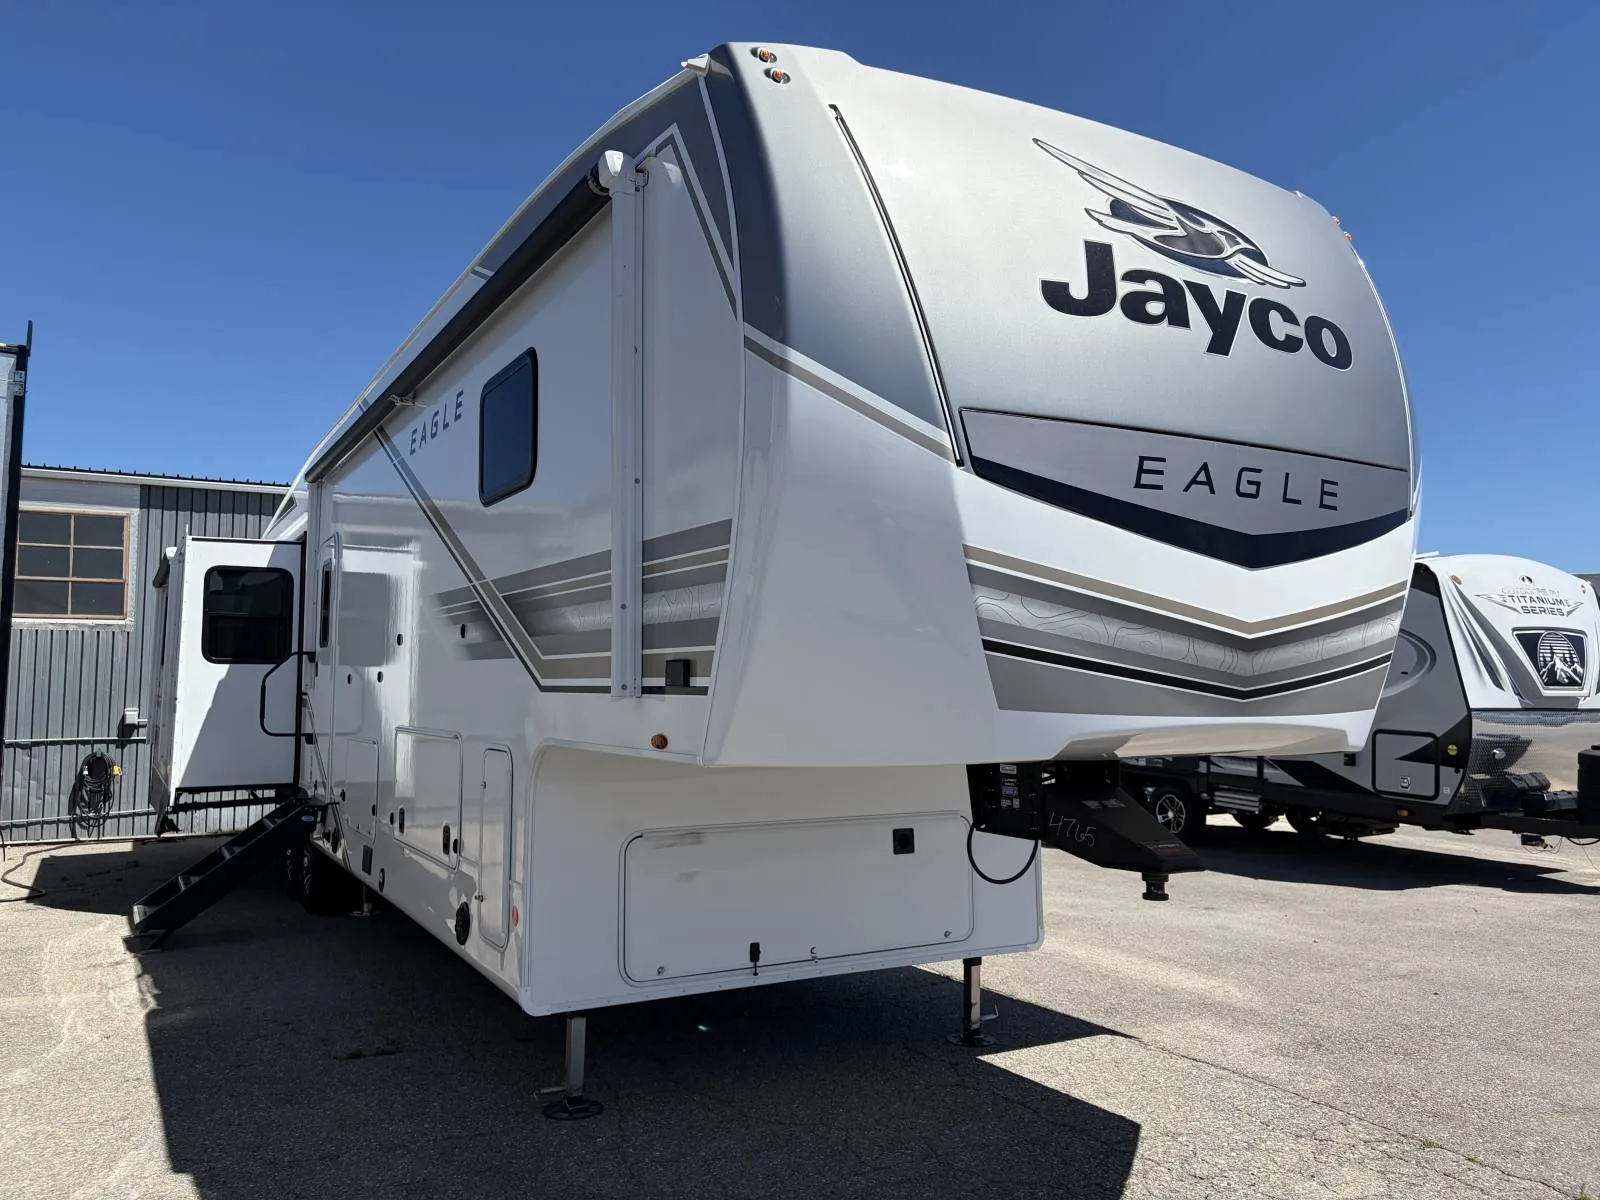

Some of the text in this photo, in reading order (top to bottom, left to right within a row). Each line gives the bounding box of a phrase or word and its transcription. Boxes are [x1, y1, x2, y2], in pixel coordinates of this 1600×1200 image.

[1040, 239, 1354, 371] Jayco
[409, 389, 464, 457] EAGLE
[1133, 455, 1340, 512] EAGLE
[1508, 595, 1565, 608] TITANIUM
[1521, 605, 1565, 617] SERIES
[1049, 811, 1097, 848] 4765
